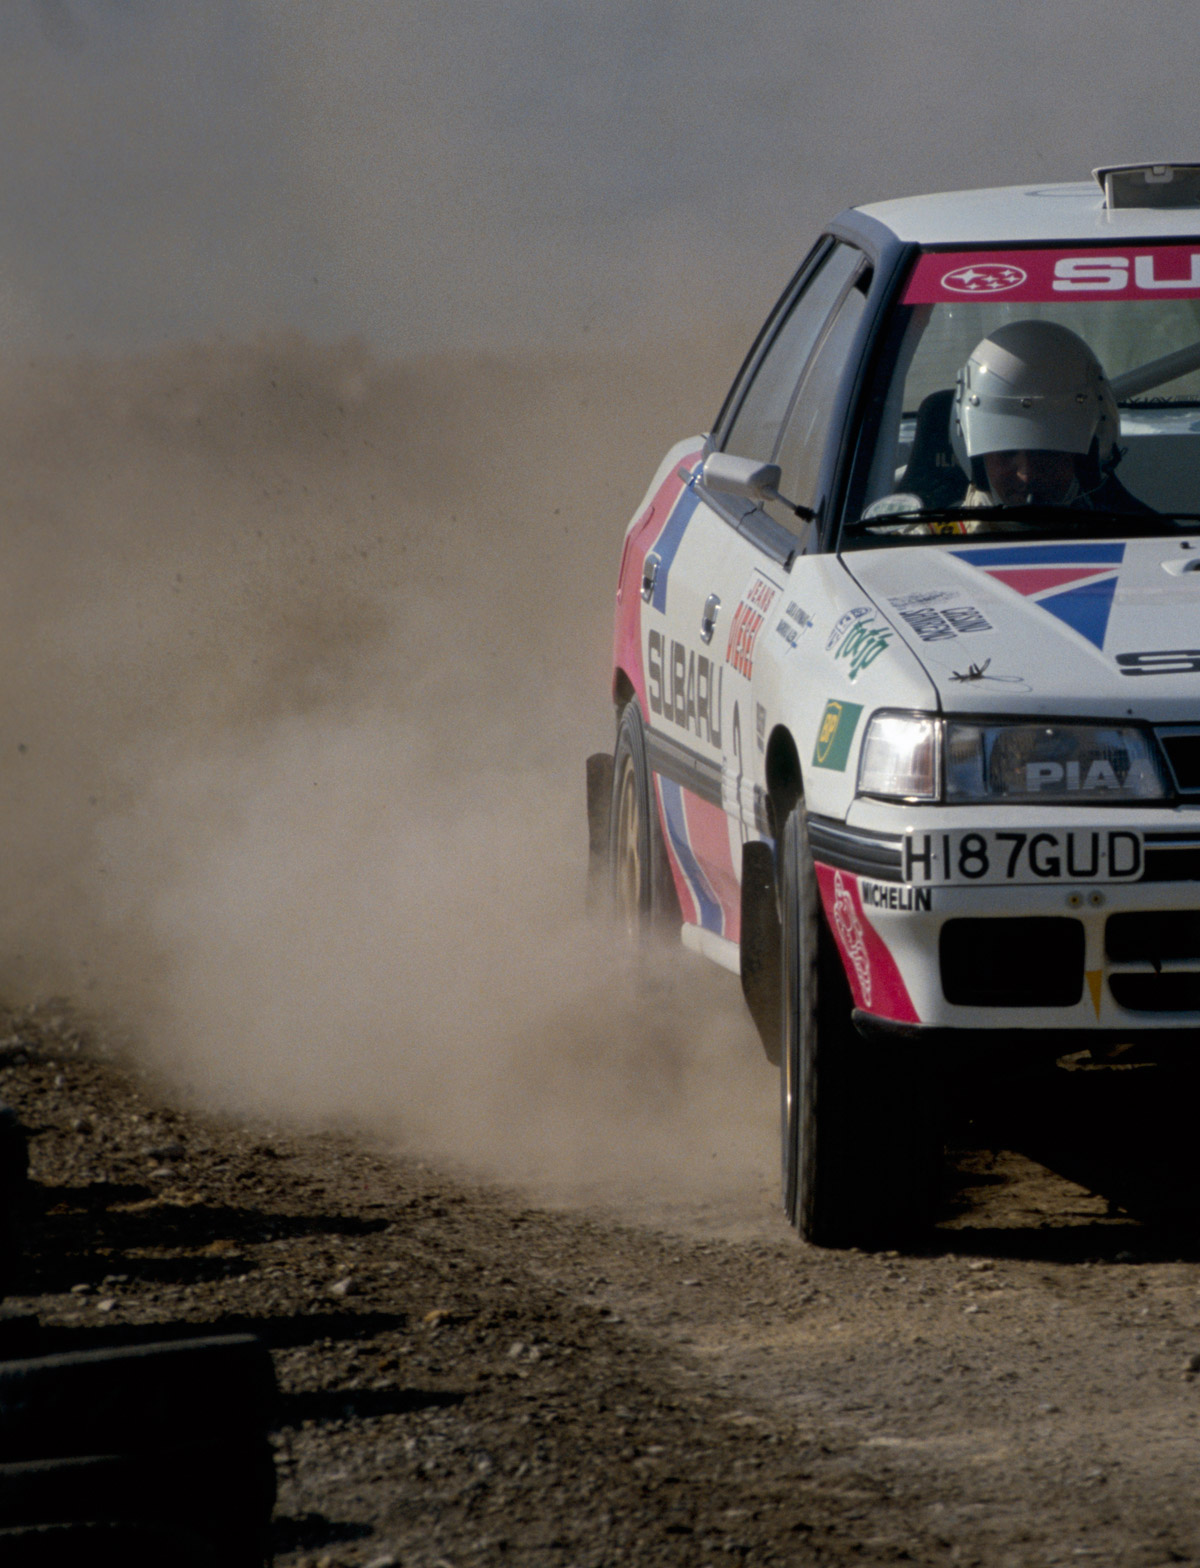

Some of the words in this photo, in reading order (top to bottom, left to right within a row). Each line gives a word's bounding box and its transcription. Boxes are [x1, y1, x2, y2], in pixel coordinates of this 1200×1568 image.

[648, 629, 723, 749] SUBARU
[819, 713, 839, 743] BP
[1026, 759, 1161, 793] PIAA
[862, 881, 932, 911] MICHELIN
